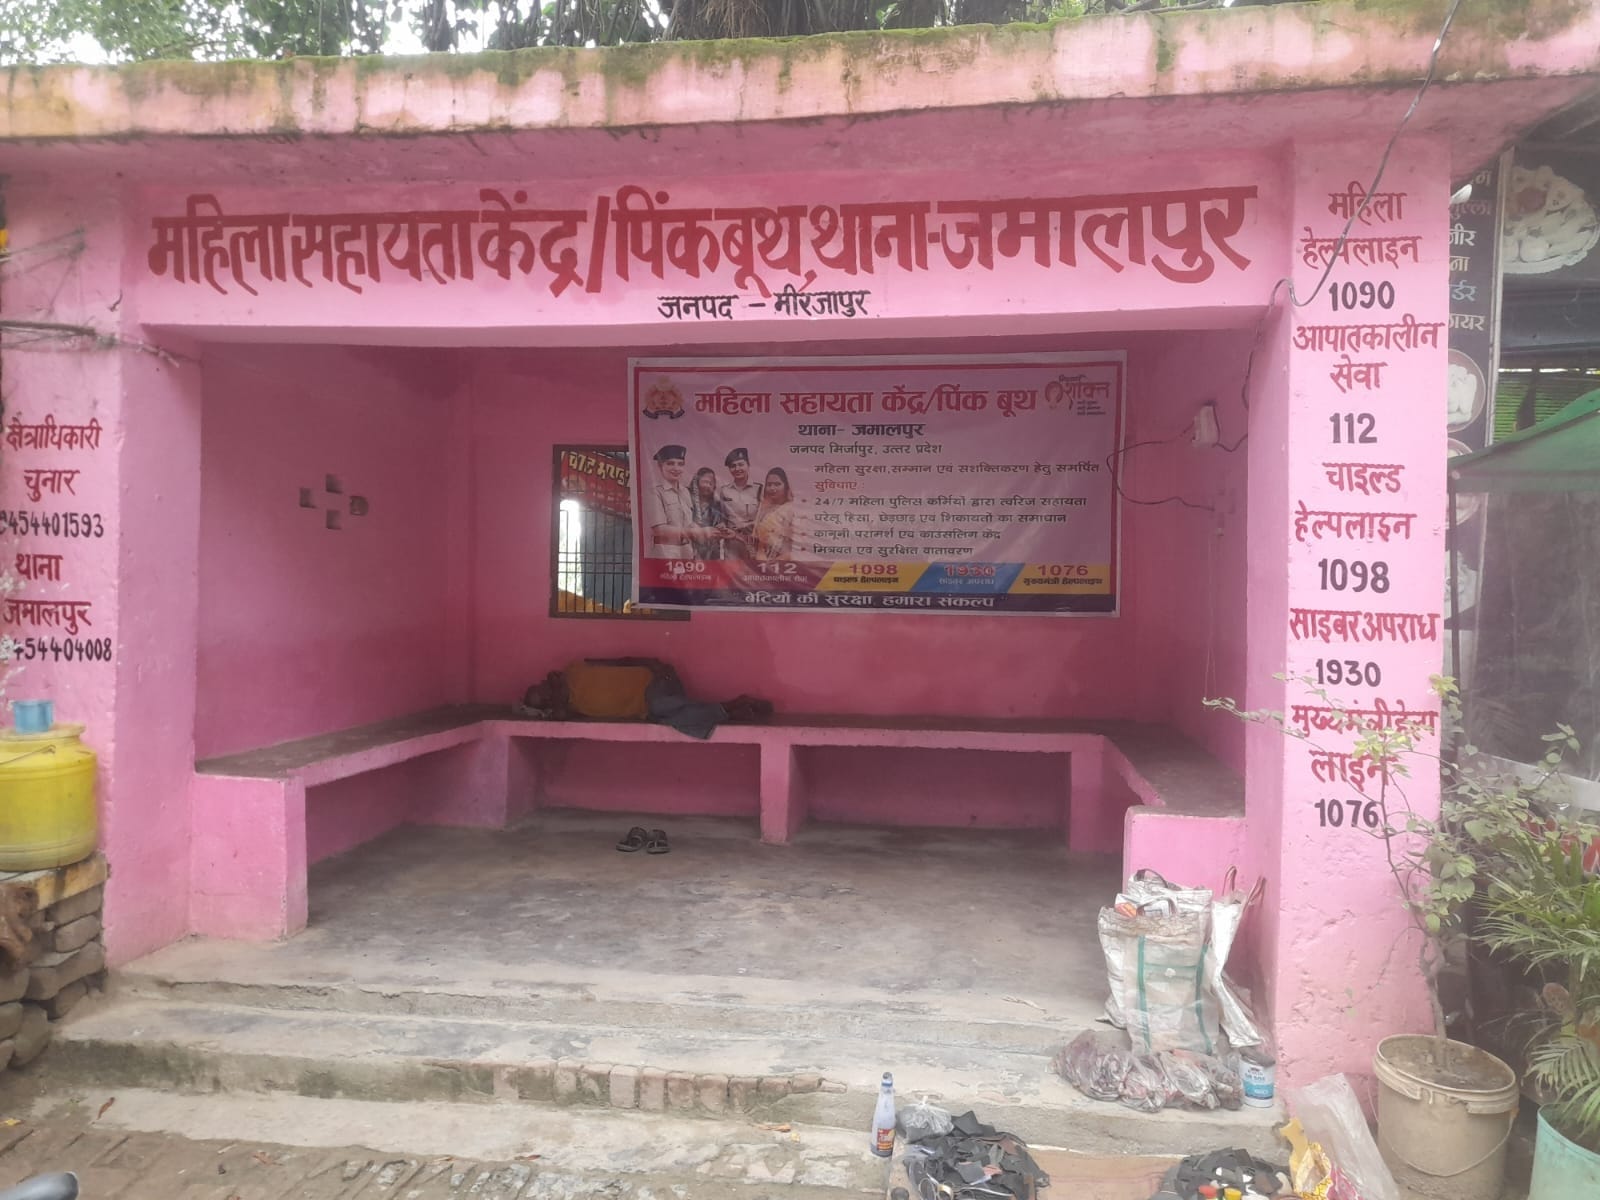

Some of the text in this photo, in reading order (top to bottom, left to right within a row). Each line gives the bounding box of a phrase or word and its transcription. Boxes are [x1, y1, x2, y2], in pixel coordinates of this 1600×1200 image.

[1327, 181, 1407, 226] महिला
[1300, 226, 1422, 270] हेल्पलाइन
[658, 295, 736, 320] जनपद
[1328, 280, 1396, 312] 1090
[1292, 313, 1446, 353] आपातकालीन
[1329, 354, 1388, 394] सेवा
[695, 386, 772, 415] महिला
[780, 391, 874, 415] सहायता
[996, 389, 1038, 417] बूथ
[852, 423, 926, 439] जमालपुर
[1328, 412, 1378, 444] 112
[790, 444, 825, 455] जनपद
[882, 443, 911, 455] उत्तर
[915, 441, 943, 455] प्रदेश
[814, 462, 850, 474] महिला
[959, 461, 1029, 473] सशक्तिकरण
[1033, 461, 1052, 476] हेतु
[1056, 460, 1100, 473] समर्पित
[1322, 462, 1406, 496] चाइल्ड
[24, 468, 81, 502] चुनार
[815, 497, 844, 507] 24/7
[849, 495, 884, 507] महिला
[889, 495, 923, 509] पुलिस
[971, 497, 995, 507] द्वारा
[1041, 497, 1088, 507] सहायता
[998, 514, 1013, 523] का
[1294, 499, 1418, 542] हेल्पलाइन
[15, 553, 63, 581] थाना
[757, 562, 798, 574] 112
[848, 563, 899, 575] 1098
[1037, 564, 1089, 576] 1076
[1318, 558, 1391, 594] 1098
[797, 591, 819, 604] की
[882, 595, 931, 607] हमारा
[938, 594, 995, 608] संकल्प
[3, 598, 92, 636] जमालपुर
[5, 637, 112, 662] 454404008
[1315, 658, 1382, 687] 1930
[1314, 798, 1380, 828] 1076
